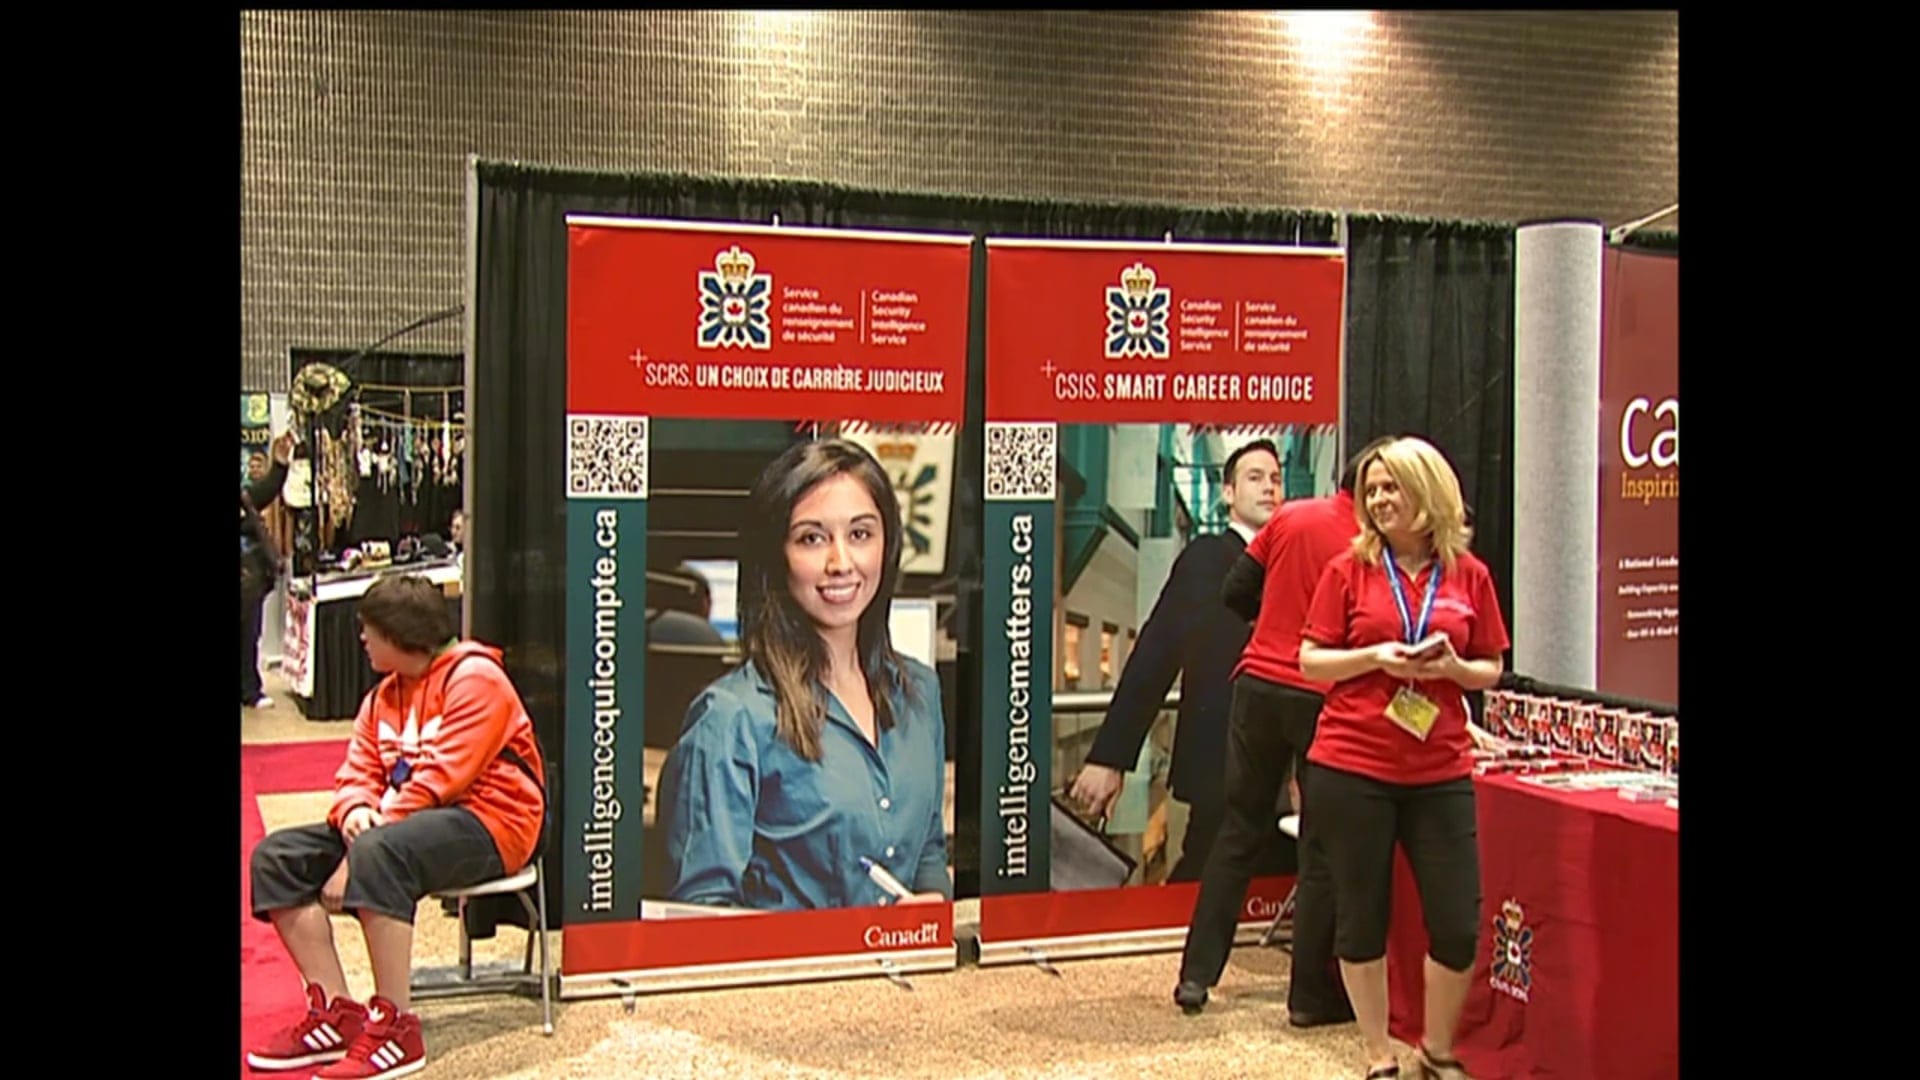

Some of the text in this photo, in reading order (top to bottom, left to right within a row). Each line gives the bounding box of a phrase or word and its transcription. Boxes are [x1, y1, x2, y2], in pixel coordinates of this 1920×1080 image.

[784, 286, 819, 299] Service
[872, 290, 918, 303] Canadian
[783, 302, 842, 315] canadian du
[872, 304, 911, 319] Security
[1180, 299, 1222, 312] Canadian
[871, 318, 926, 334] Intelligence
[871, 332, 907, 345] Service
[645, 363, 944, 393] SCRS. UN CHOIX DE CARRIÈRE JUDICIEUX
[1055, 372, 1313, 402] CSIS. SMART CAREER CHOICE
[998, 514, 1036, 878] intelligencematters.ca
[583, 509, 622, 912] intelligencequicompte.ca
[864, 922, 939, 948] Canada
